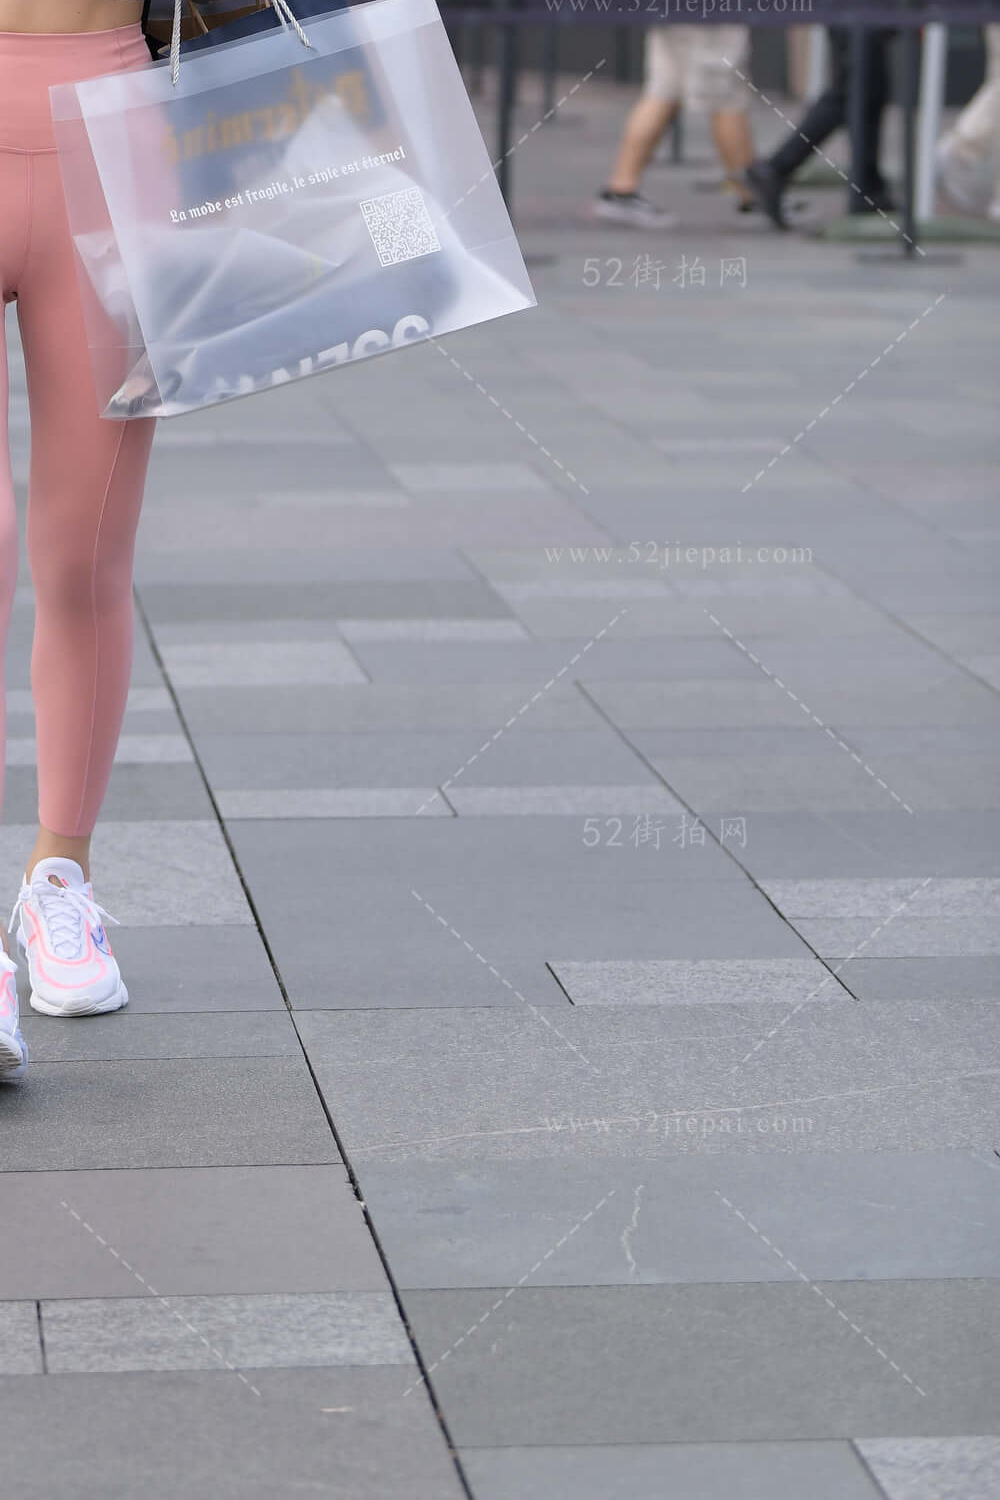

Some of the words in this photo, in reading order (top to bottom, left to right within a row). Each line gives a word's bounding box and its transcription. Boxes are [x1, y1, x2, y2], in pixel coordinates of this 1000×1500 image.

[169, 208, 187, 223] La
[188, 201, 223, 219] mode
[224, 192, 244, 209] est
[308, 166, 339, 184] style
[341, 160, 361, 175] est
